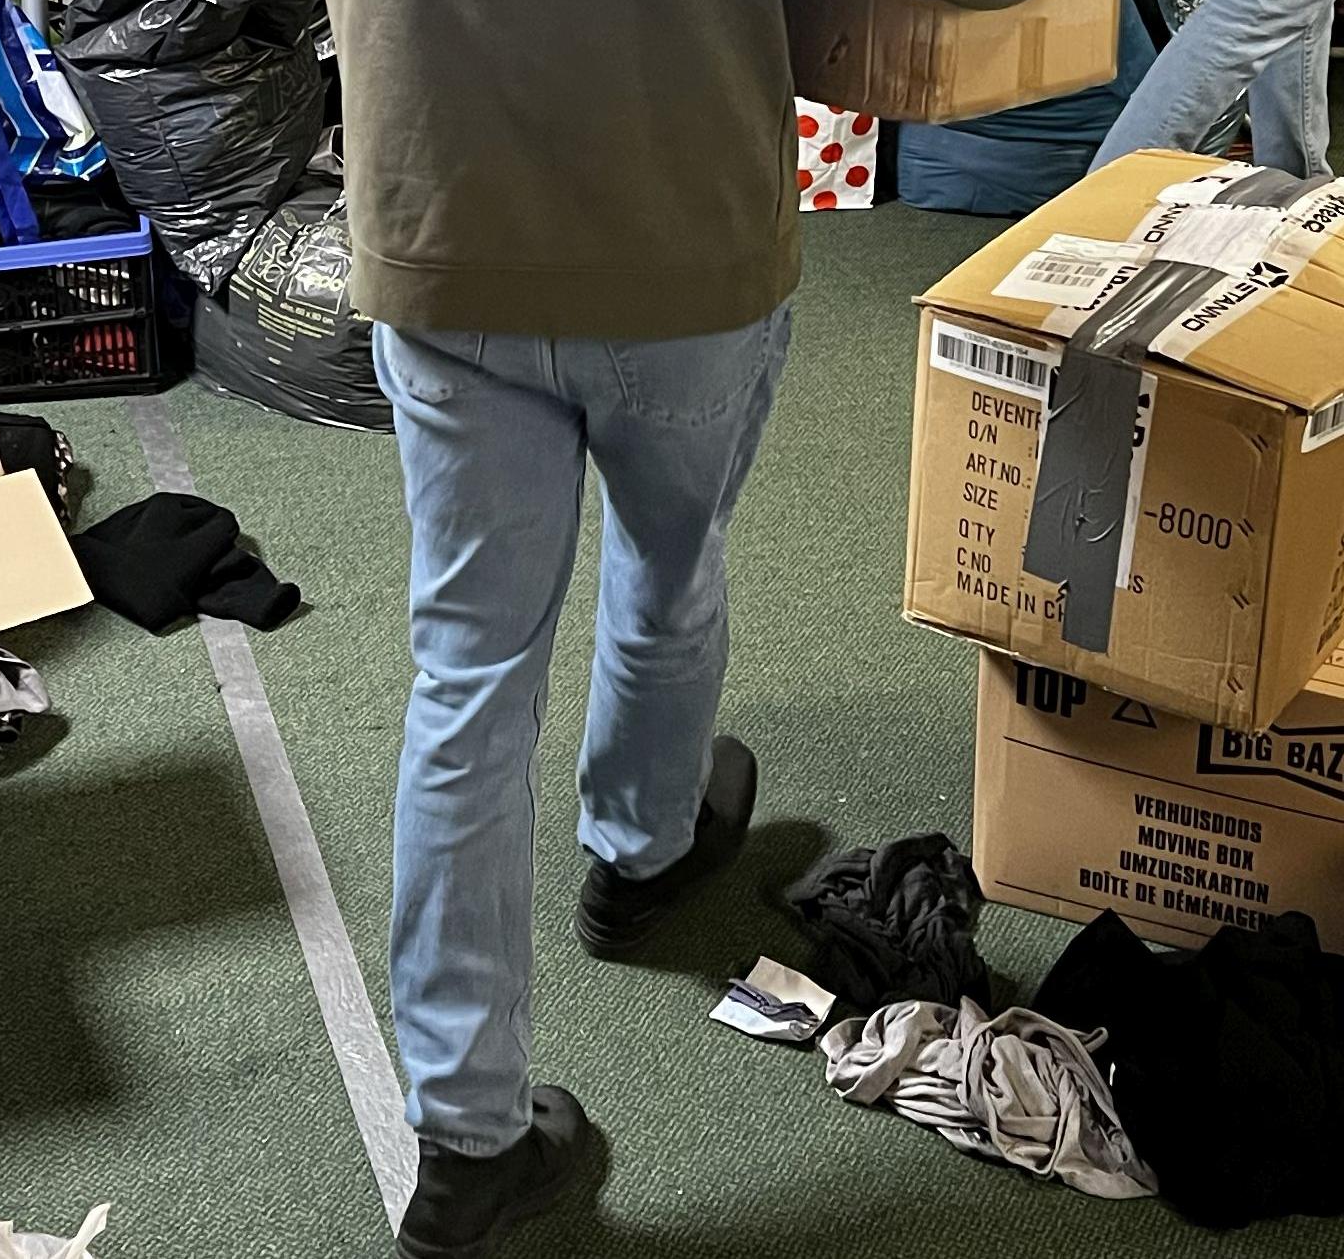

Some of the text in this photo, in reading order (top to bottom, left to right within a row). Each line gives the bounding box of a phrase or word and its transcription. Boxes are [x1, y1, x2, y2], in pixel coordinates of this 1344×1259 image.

[968, 420, 998, 444] O/N
[963, 482, 998, 511] SIZE
[957, 571, 1011, 607] MADE
[1018, 591, 1036, 614] IN
[1013, 660, 1088, 718] TOP
[1222, 728, 1273, 761] BIG
[1134, 793, 1262, 843] VERHUISDOOS
[1138, 825, 1254, 871] MOVING BOX
[1079, 868, 1129, 898] BOÎTE
[1135, 882, 1156, 906] DE
[1119, 850, 1269, 904] UMZUGSKARTON
